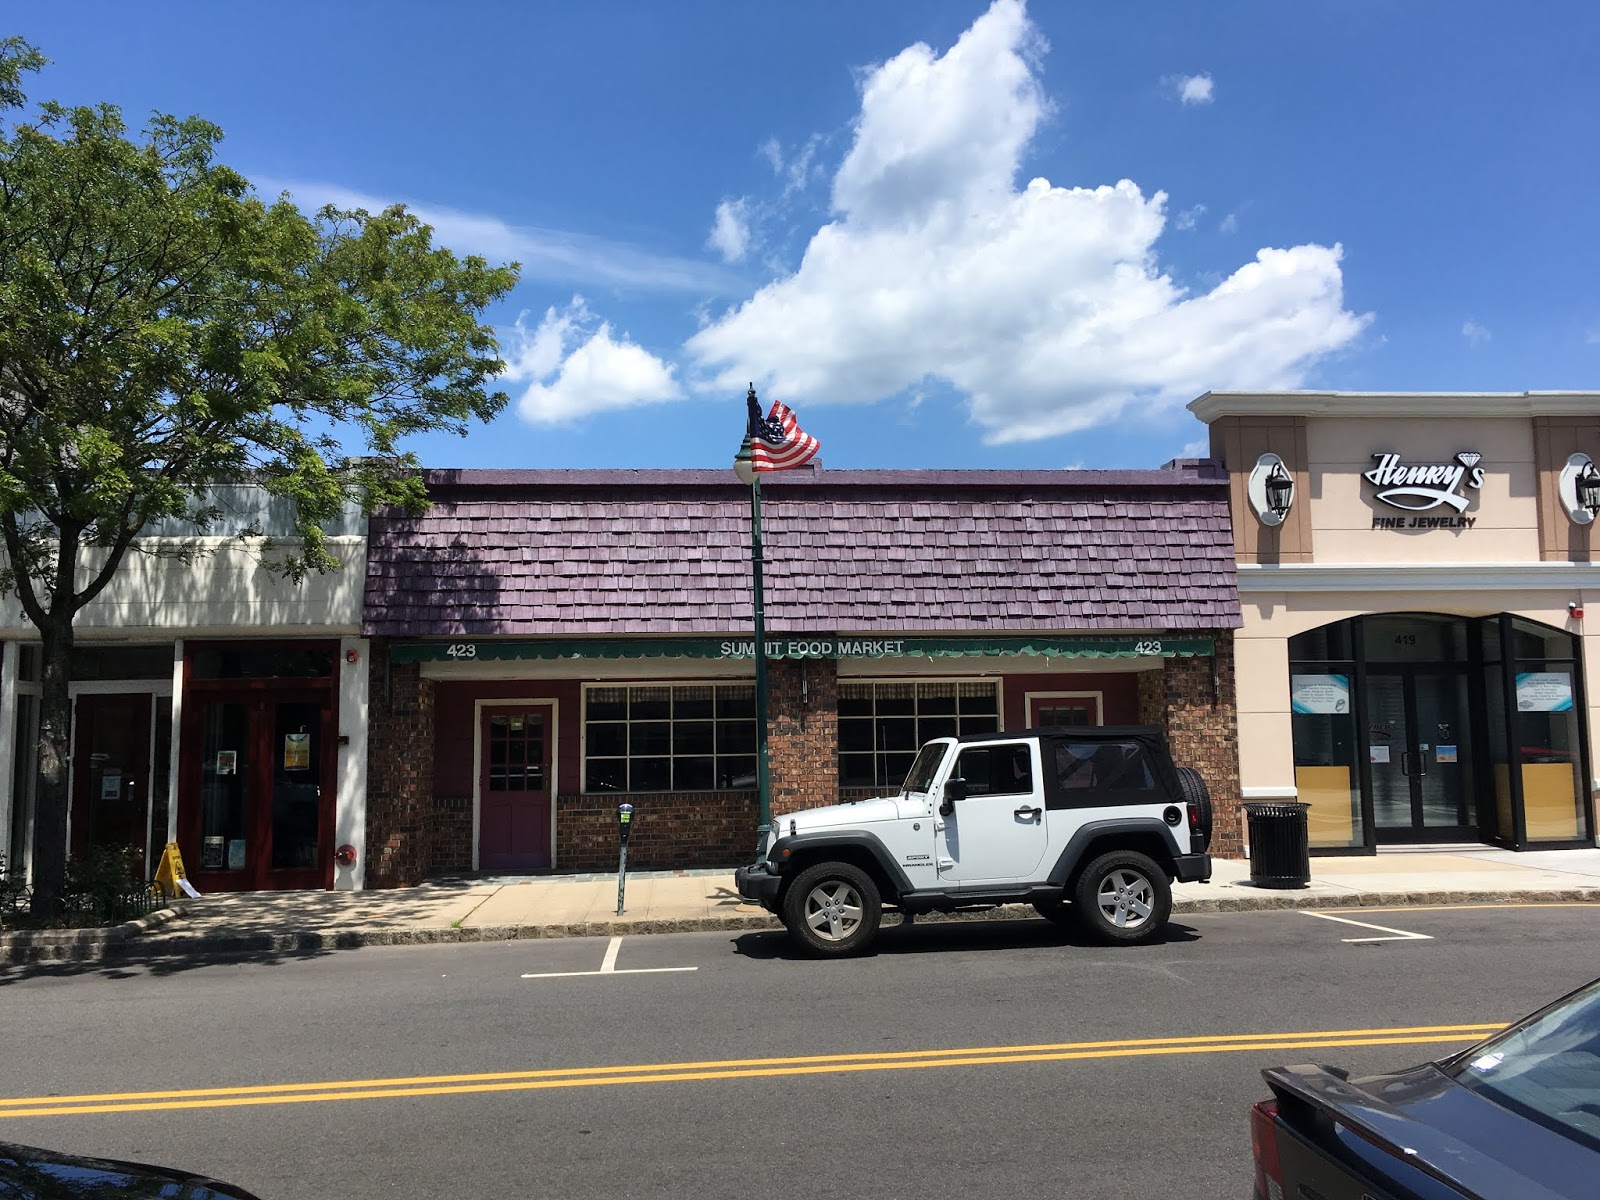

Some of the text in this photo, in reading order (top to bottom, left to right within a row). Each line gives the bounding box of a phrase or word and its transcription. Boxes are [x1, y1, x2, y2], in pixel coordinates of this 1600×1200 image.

[1361, 452, 1485, 512] Henry's
[1372, 517, 1476, 529] FINE JEWELRY
[1395, 635, 1416, 645] 419
[446, 644, 476, 657] 423
[720, 640, 904, 655] SUMIT FOOD MARKET
[1134, 641, 1162, 654] 423
